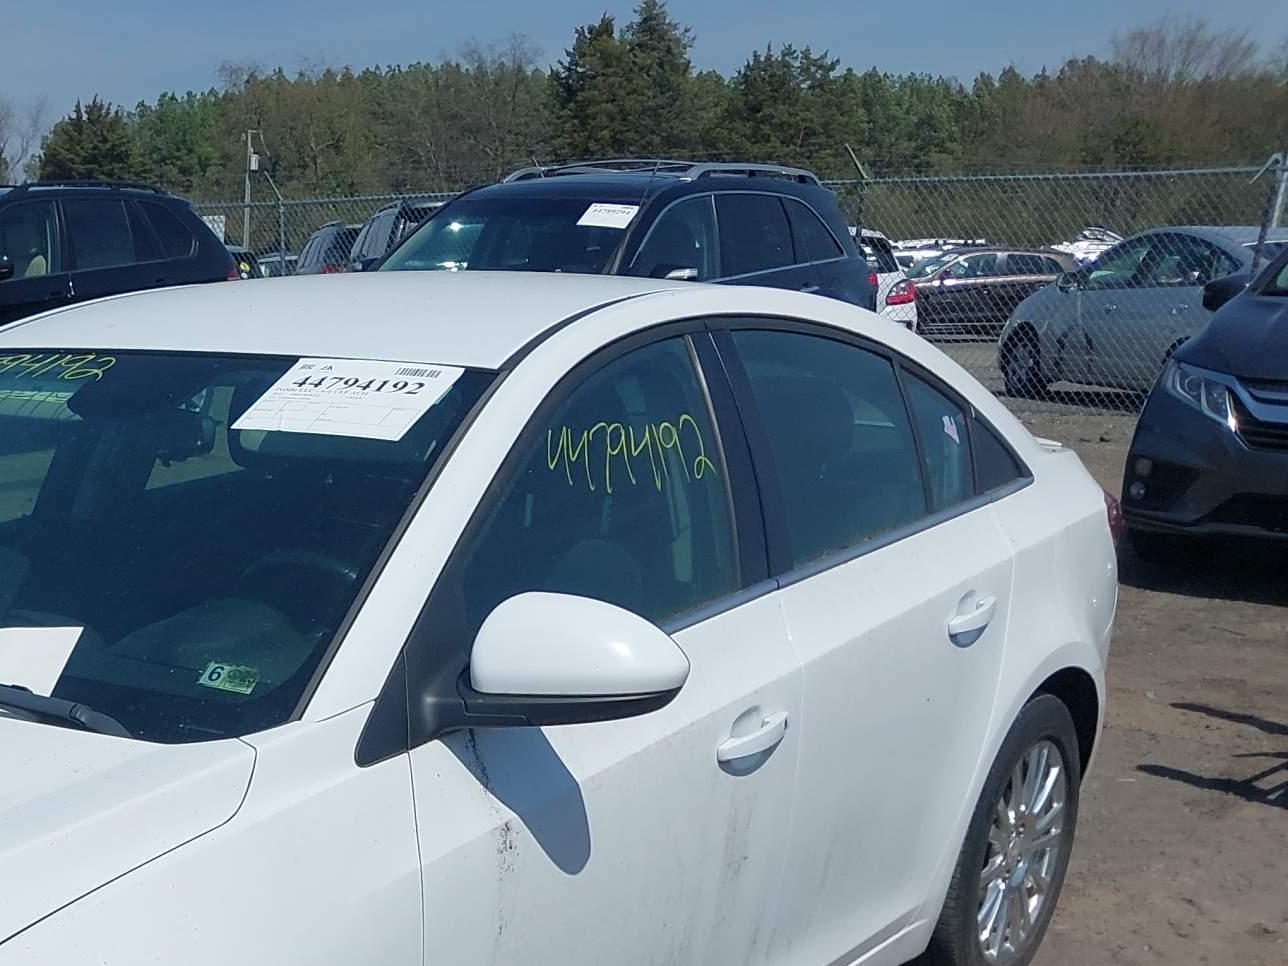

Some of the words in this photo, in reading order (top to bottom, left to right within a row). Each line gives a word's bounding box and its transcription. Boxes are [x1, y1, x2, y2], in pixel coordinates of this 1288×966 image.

[292, 375, 426, 395] 44794192
[548, 414, 717, 494] 44794192
[208, 666, 225, 681] 6
